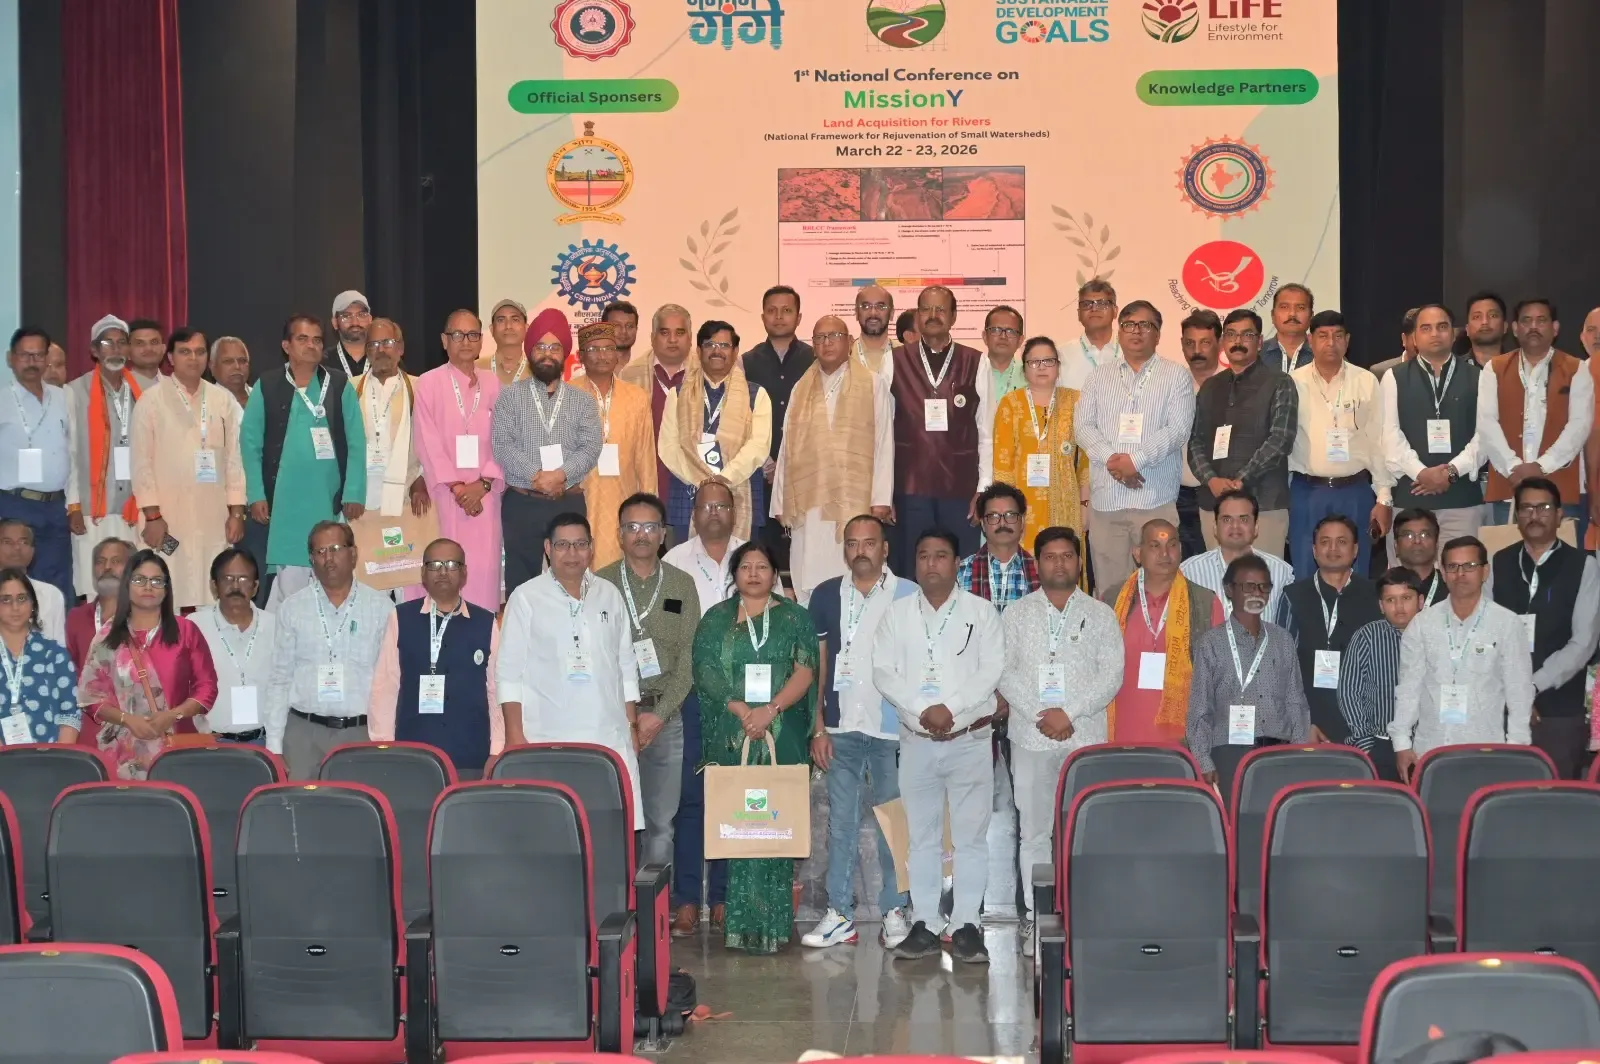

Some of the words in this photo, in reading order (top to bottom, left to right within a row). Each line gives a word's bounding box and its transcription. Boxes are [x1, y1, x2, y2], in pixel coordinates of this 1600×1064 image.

[996, 6, 1109, 18] DEVELOPMENT
[995, 18, 1110, 44] GOALS
[1208, 23, 1257, 33] Lifestyle
[1261, 22, 1278, 32] for
[1208, 32, 1283, 41] Environment
[793, 69, 809, 82] 1st
[815, 68, 889, 82] National
[893, 67, 992, 81] Conference
[997, 71, 1019, 80] on
[1148, 82, 1235, 97] Knowledge
[1239, 82, 1307, 94] Partners
[527, 92, 585, 104] Official
[589, 91, 662, 105] Sponsers
[844, 88, 964, 109] MissionY
[823, 118, 854, 128] Land
[857, 117, 928, 131] Acquisition
[931, 117, 949, 127] for
[952, 117, 991, 126] Rivers
[764, 132, 809, 142] (National
[810, 132, 864, 141] Framework
[866, 131, 880, 140] for
[882, 131, 946, 141] Rejuvenation
[948, 131, 958, 139] of
[960, 131, 988, 139] Small
[989, 130, 1050, 139] Watersheds)
[836, 145, 881, 156] March
[886, 145, 903, 156] 22
[915, 145, 937, 157] 23,
[940, 144, 978, 155] 2026
[1167, 278, 1191, 311] Reaching
[1256, 275, 1279, 308] Tomorrow
